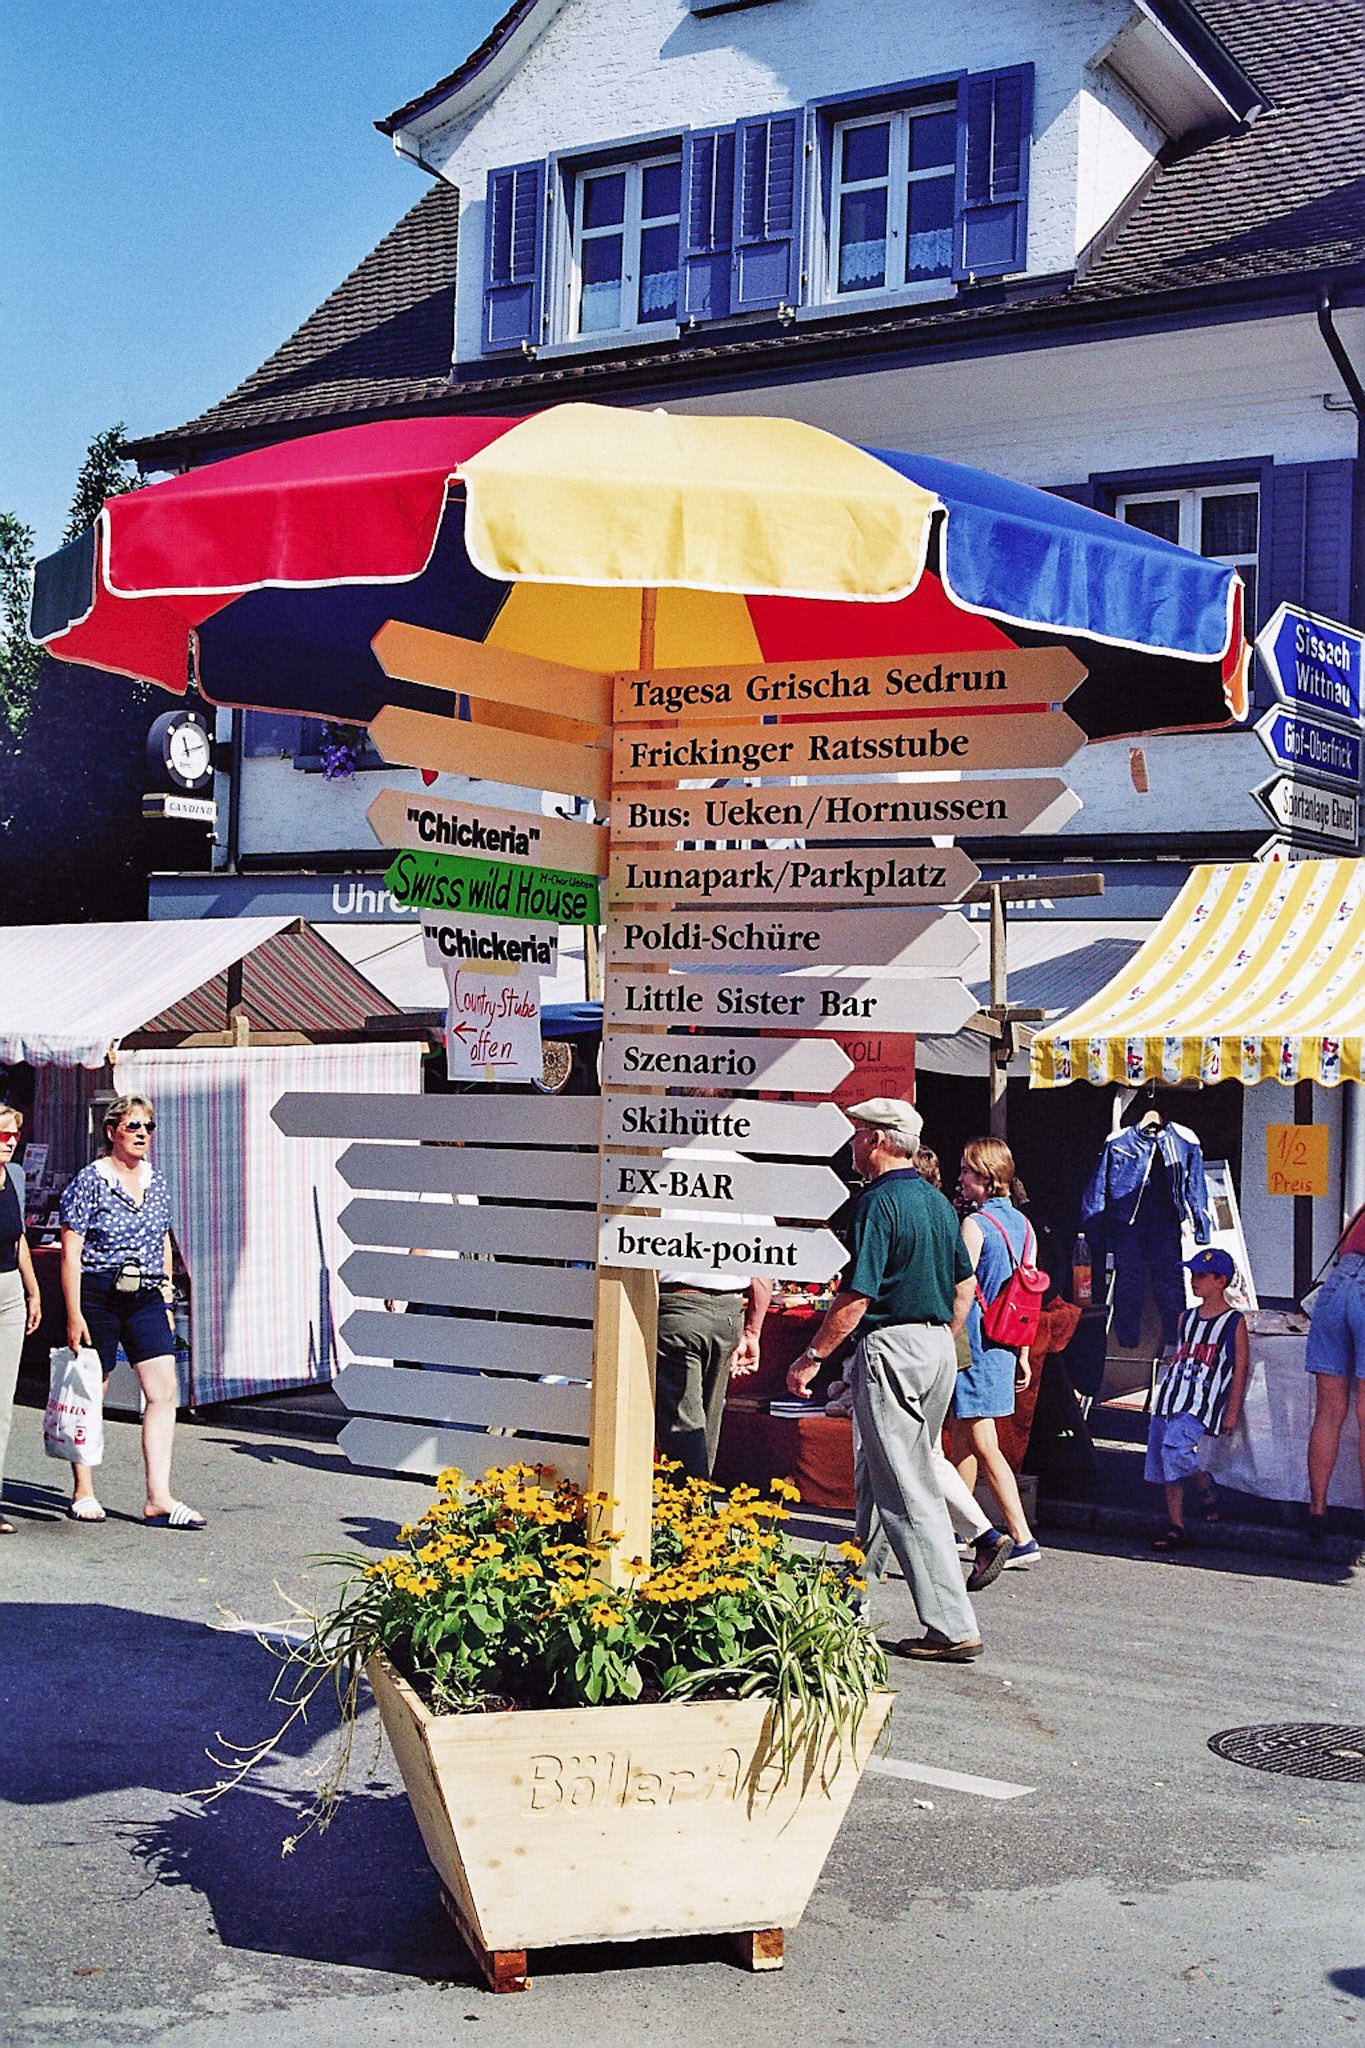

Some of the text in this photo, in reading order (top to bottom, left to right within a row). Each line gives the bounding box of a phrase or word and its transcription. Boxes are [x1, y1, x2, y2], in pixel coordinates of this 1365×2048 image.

[1295, 623, 1350, 671] Sissach
[630, 663, 1008, 713] Tagesa Grischa Sedrun
[1295, 660, 1350, 708] Wittnau
[630, 728, 969, 771] Frickinger Ratsstube
[1284, 721, 1353, 770] Gipf-Oberfrick
[169, 802, 213, 815] CANDINO
[628, 802, 690, 828] Bus:
[1283, 786, 1329, 831] Sportanlage
[407, 808, 540, 855] "Chickeria"
[393, 854, 587, 920] Swiss wild House
[625, 860, 946, 896] Lunapark/Parkplatz
[332, 883, 418, 914] Uhre
[424, 926, 558, 964] "Chickeria"
[624, 923, 820, 951] Poldi-Schüre
[454, 970, 538, 1028] Country-Stube
[625, 985, 877, 1018] Little Sister Bar
[470, 1031, 512, 1062] offen
[623, 1047, 756, 1076] Szenario
[622, 1106, 750, 1138] Skihütte
[1278, 1129, 1308, 1168] 1/2
[617, 1168, 734, 1200] EX-BAR
[1271, 1171, 1312, 1193] Preis
[617, 1226, 798, 1269] break-point
